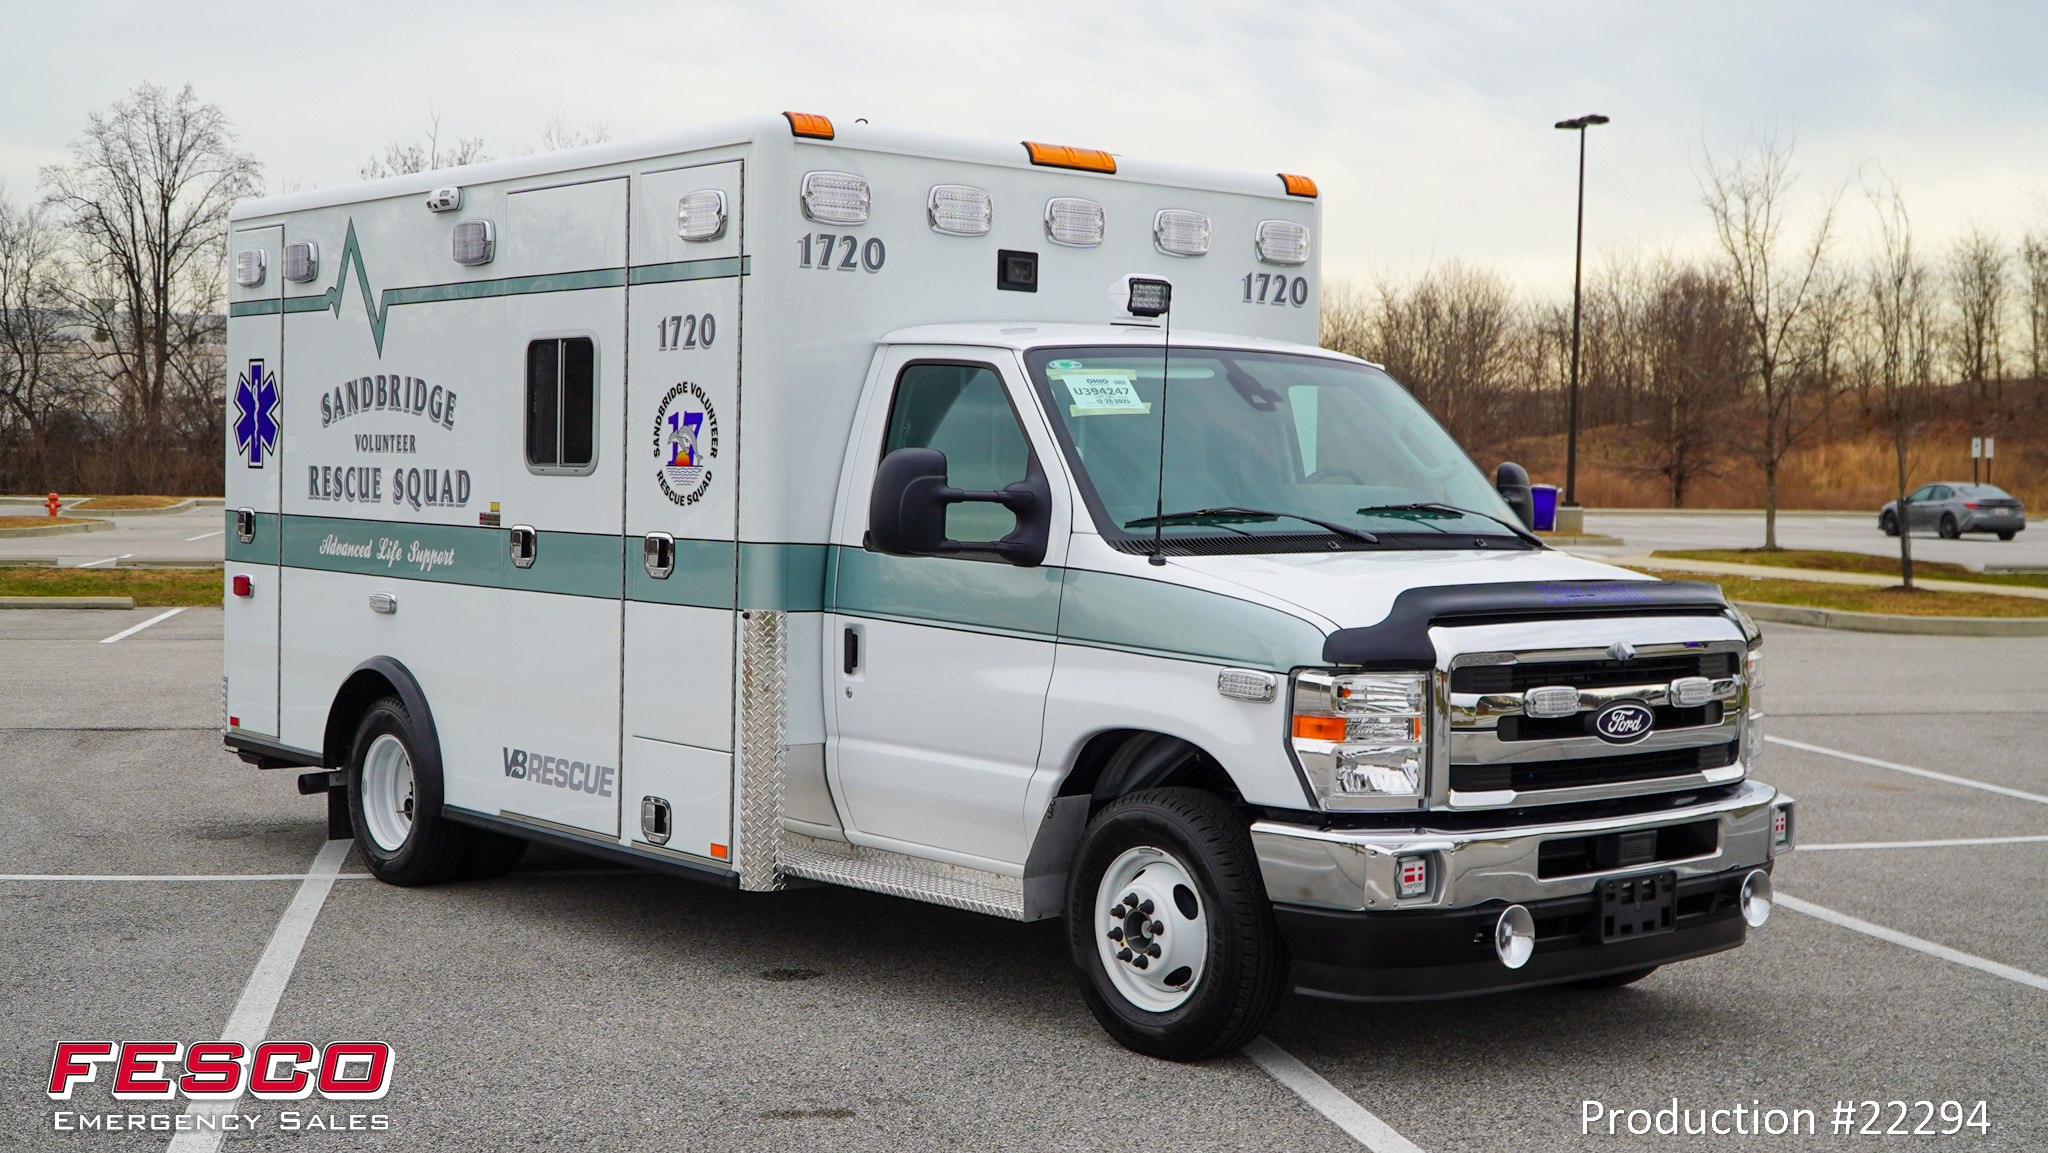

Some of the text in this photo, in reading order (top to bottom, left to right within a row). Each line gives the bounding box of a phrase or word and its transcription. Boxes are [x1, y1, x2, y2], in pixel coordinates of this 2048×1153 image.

[797, 232, 886, 275] 1720
[1241, 271, 1308, 309] 1720
[657, 313, 716, 352] 1720
[320, 374, 457, 431] SANDBRIDGE
[1073, 387, 1129, 396] U394247
[653, 382, 719, 459] SANDBRIDGE VOLUNTEER
[667, 410, 704, 467] 17
[354, 433, 417, 454] VOLUNTEER
[308, 465, 471, 512] RESCUE SQUAD
[656, 469, 713, 507] RESCUE SQUAD
[319, 534, 455, 572] Advanced Life Support
[1607, 709, 1643, 733] Ford
